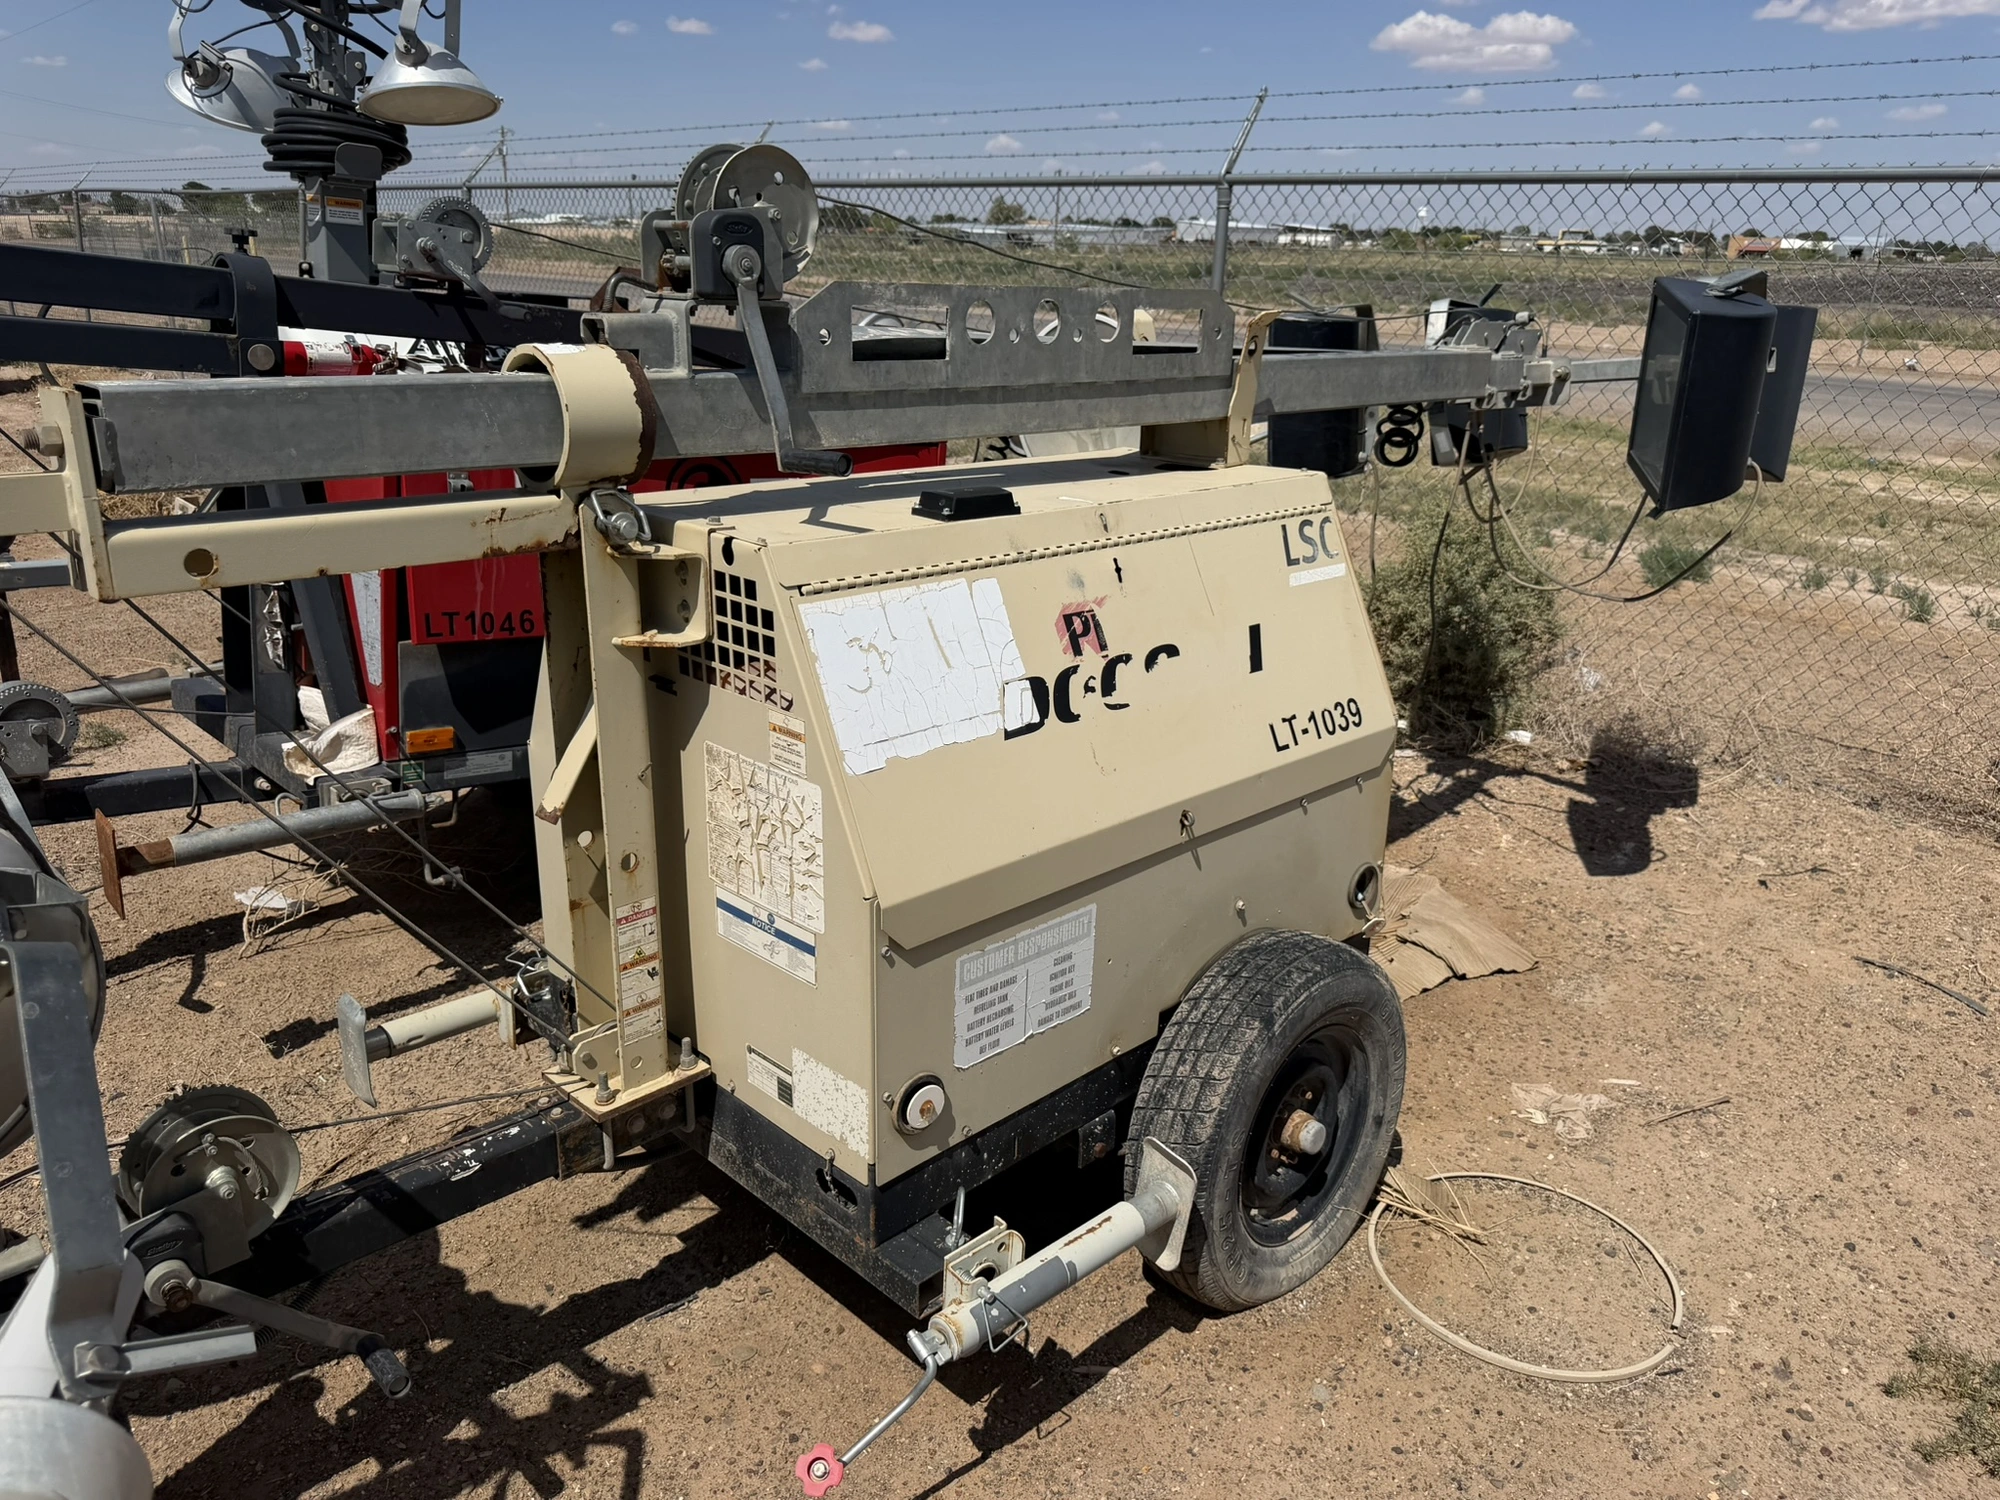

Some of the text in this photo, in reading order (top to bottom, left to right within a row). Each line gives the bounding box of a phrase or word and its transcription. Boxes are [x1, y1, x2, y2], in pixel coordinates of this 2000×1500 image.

[1280, 515, 1339, 567] LSC
[424, 609, 535, 638] LT1046
[1268, 697, 1362, 752] LT-1039
[628, 909, 654, 922] DANGER
[751, 917, 777, 935] NOTICE
[963, 914, 1090, 982] CUSTOMER RESPONSIBILITY
[629, 954, 658, 968] WARNING
[989, 982, 999, 994] AND
[999, 974, 1018, 990] DAMAGE
[632, 998, 661, 1013] WARNING
